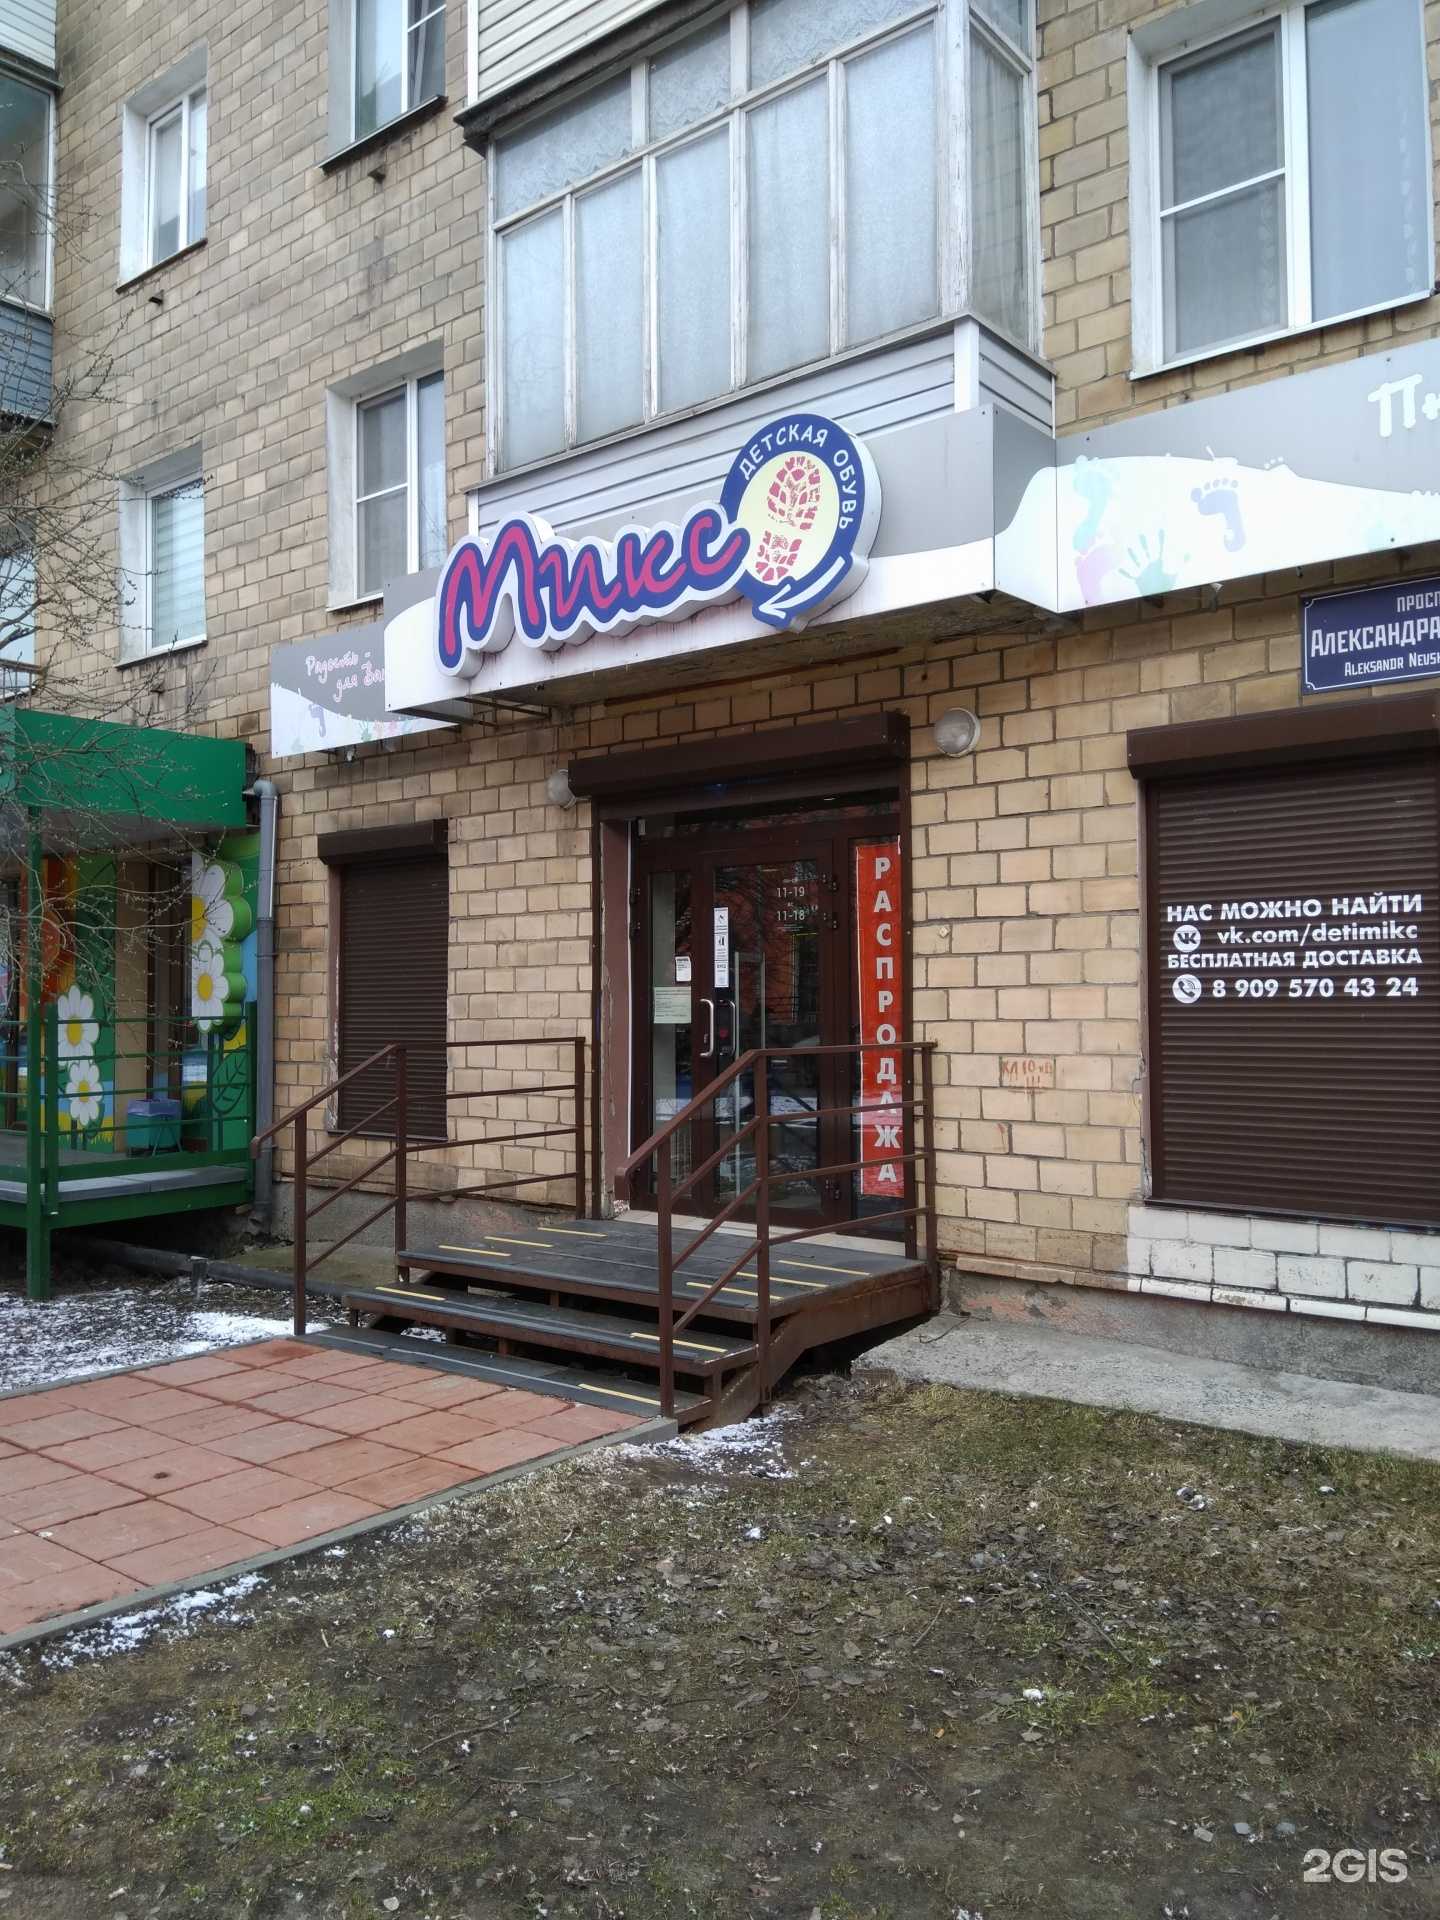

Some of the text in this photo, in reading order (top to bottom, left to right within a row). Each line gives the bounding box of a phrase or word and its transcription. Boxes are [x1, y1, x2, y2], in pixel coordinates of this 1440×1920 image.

[739, 424, 857, 530] ДЕТСКАЯ ОБУВЬ
[440, 512, 748, 664] Микс
[1311, 616, 1440, 658] АЛЕКСАНДРА
[1345, 657, 1404, 677] ALEKSANDR
[776, 886, 805, 898] 11-19
[776, 910, 805, 921] 11-18
[1167, 891, 1422, 922] НАС МОЖНО НАЙТИ
[1217, 920, 1418, 946] vk.com/detimikc
[1168, 949, 1422, 969] БЕСПЛАТНАЯ ДОСТАВКА
[1212, 977, 1419, 997] 8 909 570 43 24
[874, 857, 901, 1182] РАСПРОДАЖА
